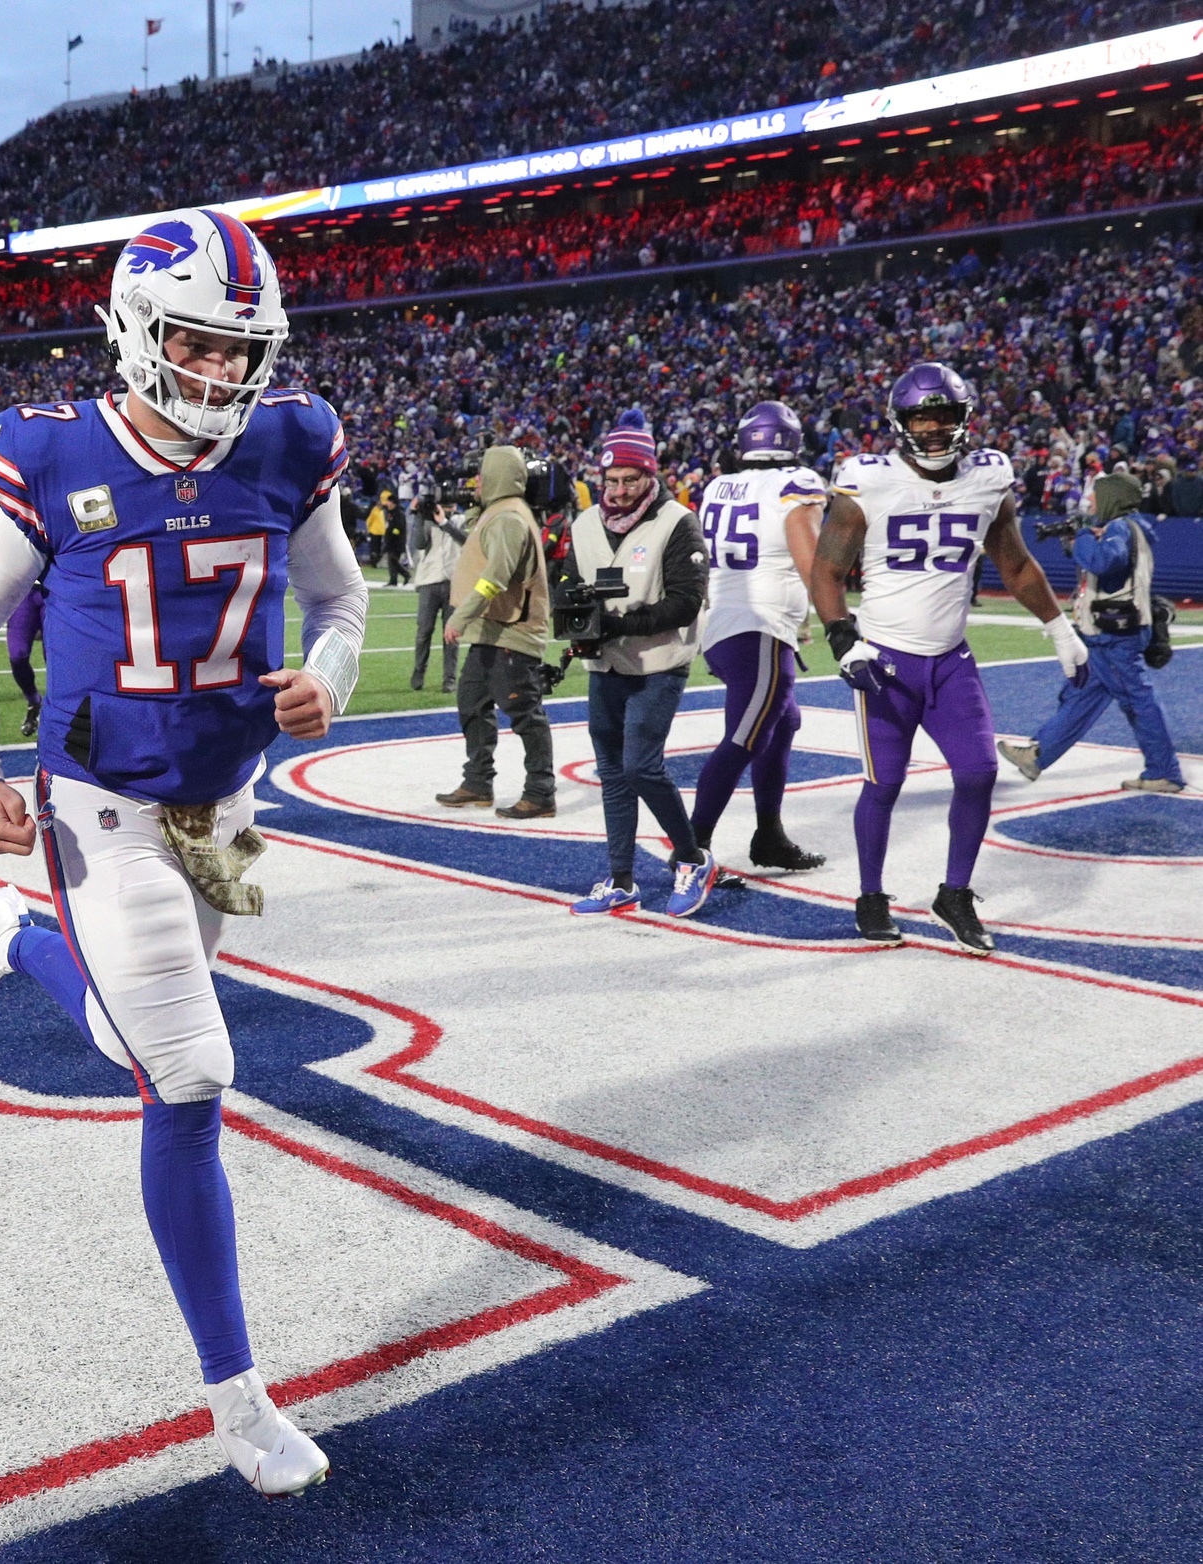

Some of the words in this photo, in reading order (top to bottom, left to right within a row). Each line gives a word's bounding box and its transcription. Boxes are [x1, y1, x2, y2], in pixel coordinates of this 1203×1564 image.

[364, 181, 395, 201] THE
[396, 171, 467, 197] OFFICIAL
[468, 160, 527, 185] FINGER
[529, 150, 578, 175] FOOD
[580, 144, 606, 168] OF
[607, 140, 643, 163] THE
[645, 124, 729, 155] BUFFALO
[731, 113, 786, 141] BILLS
[73, 489, 111, 523] C
[715, 482, 749, 500] TONGA
[165, 515, 211, 532] BILLS
[703, 503, 759, 570] 95
[887, 513, 979, 572] 55
[104, 533, 268, 694] 17
